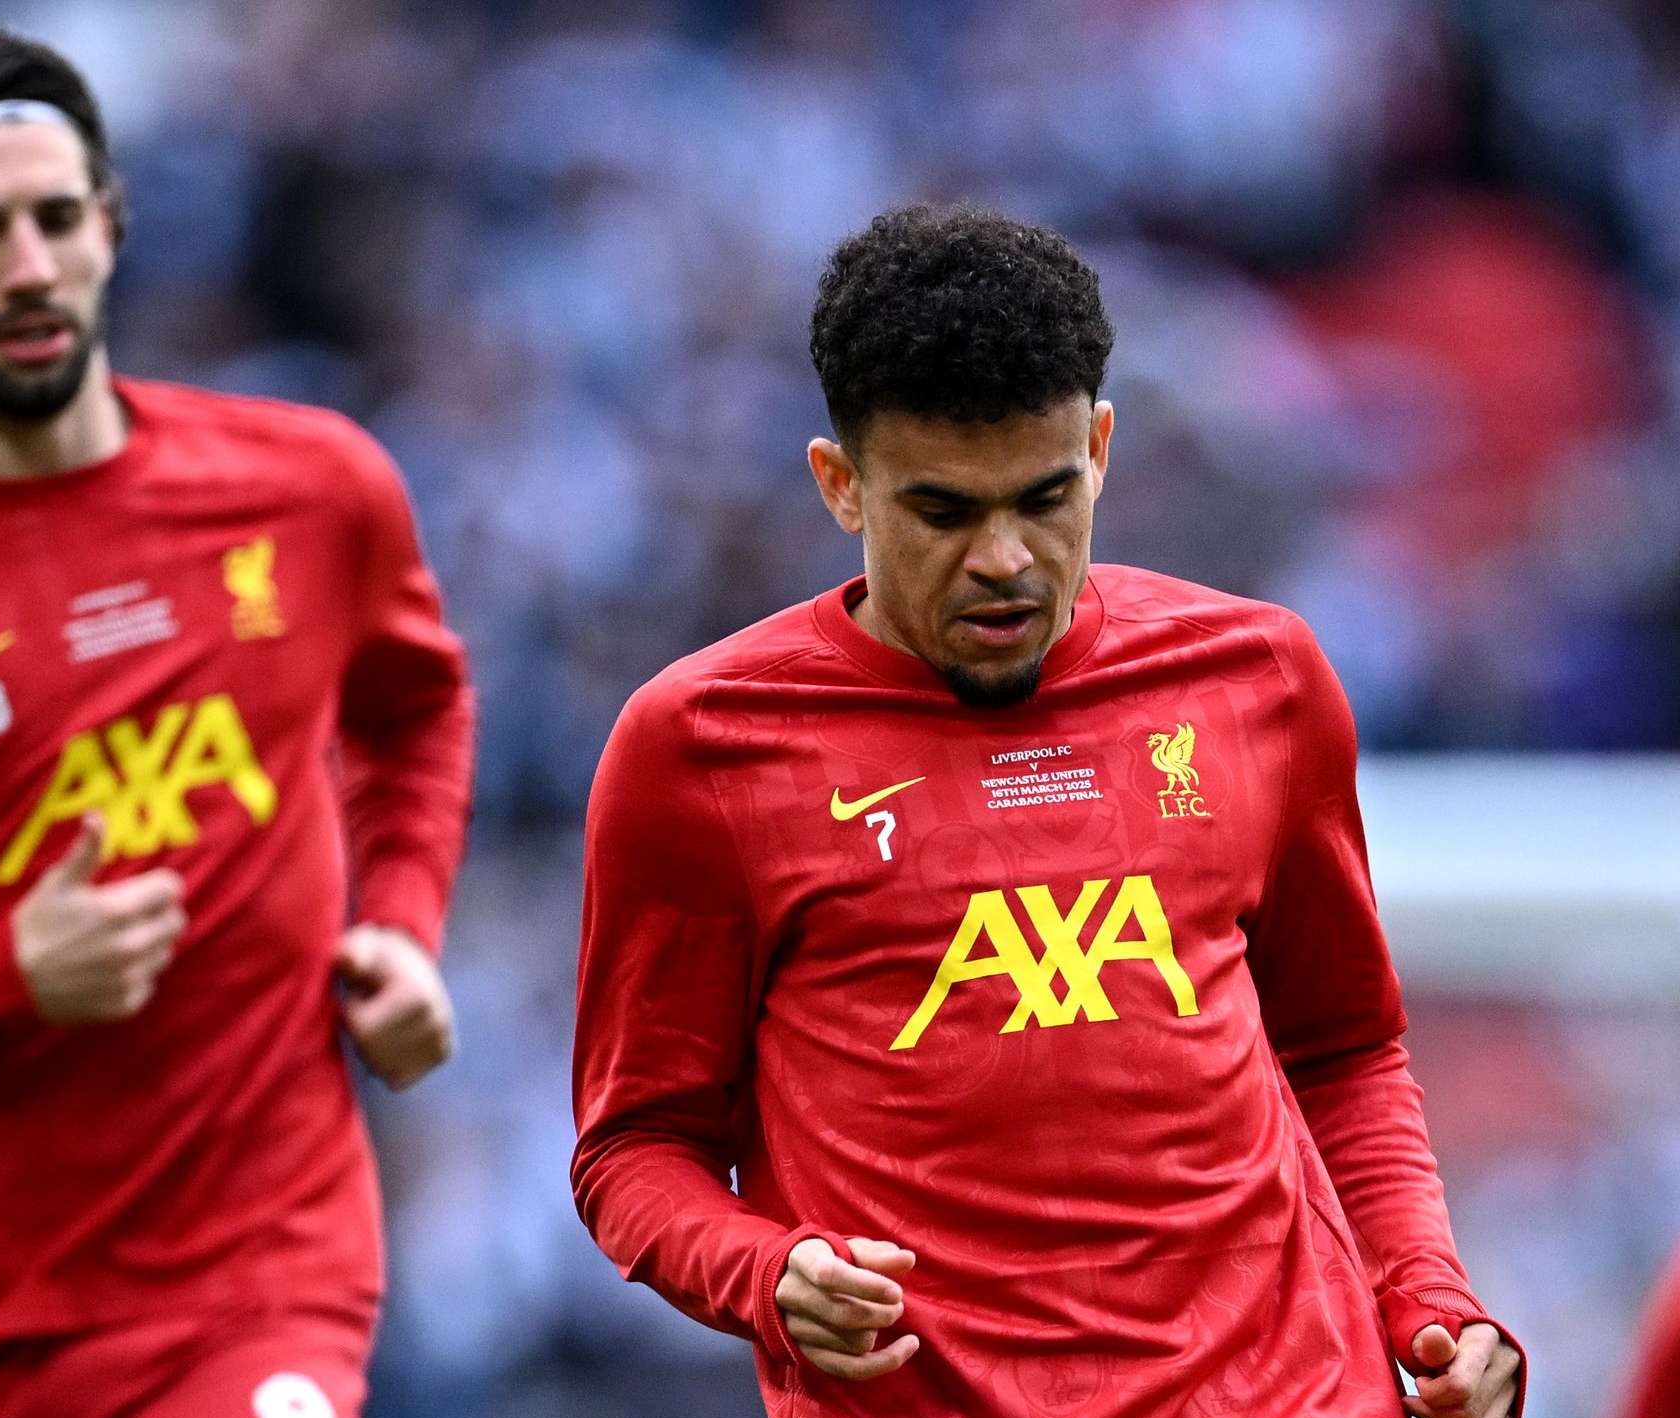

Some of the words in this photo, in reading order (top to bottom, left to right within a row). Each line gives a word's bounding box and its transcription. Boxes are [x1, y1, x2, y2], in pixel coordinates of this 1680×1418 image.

[991, 747, 1056, 765] LIVERPOOL
[1057, 745, 1072, 756] FC
[980, 773, 1050, 789] NEWCASTLE
[1051, 768, 1095, 781] UNITED
[987, 795, 1043, 809] CARABAO
[1044, 793, 1068, 804] CUP
[1069, 789, 1104, 801] FINAL
[991, 787, 1019, 798] 16TH
[1020, 783, 1064, 795] MARCH
[1064, 780, 1092, 791] 2025
[865, 810, 896, 862] 7
[888, 875, 1200, 1050] AXA
